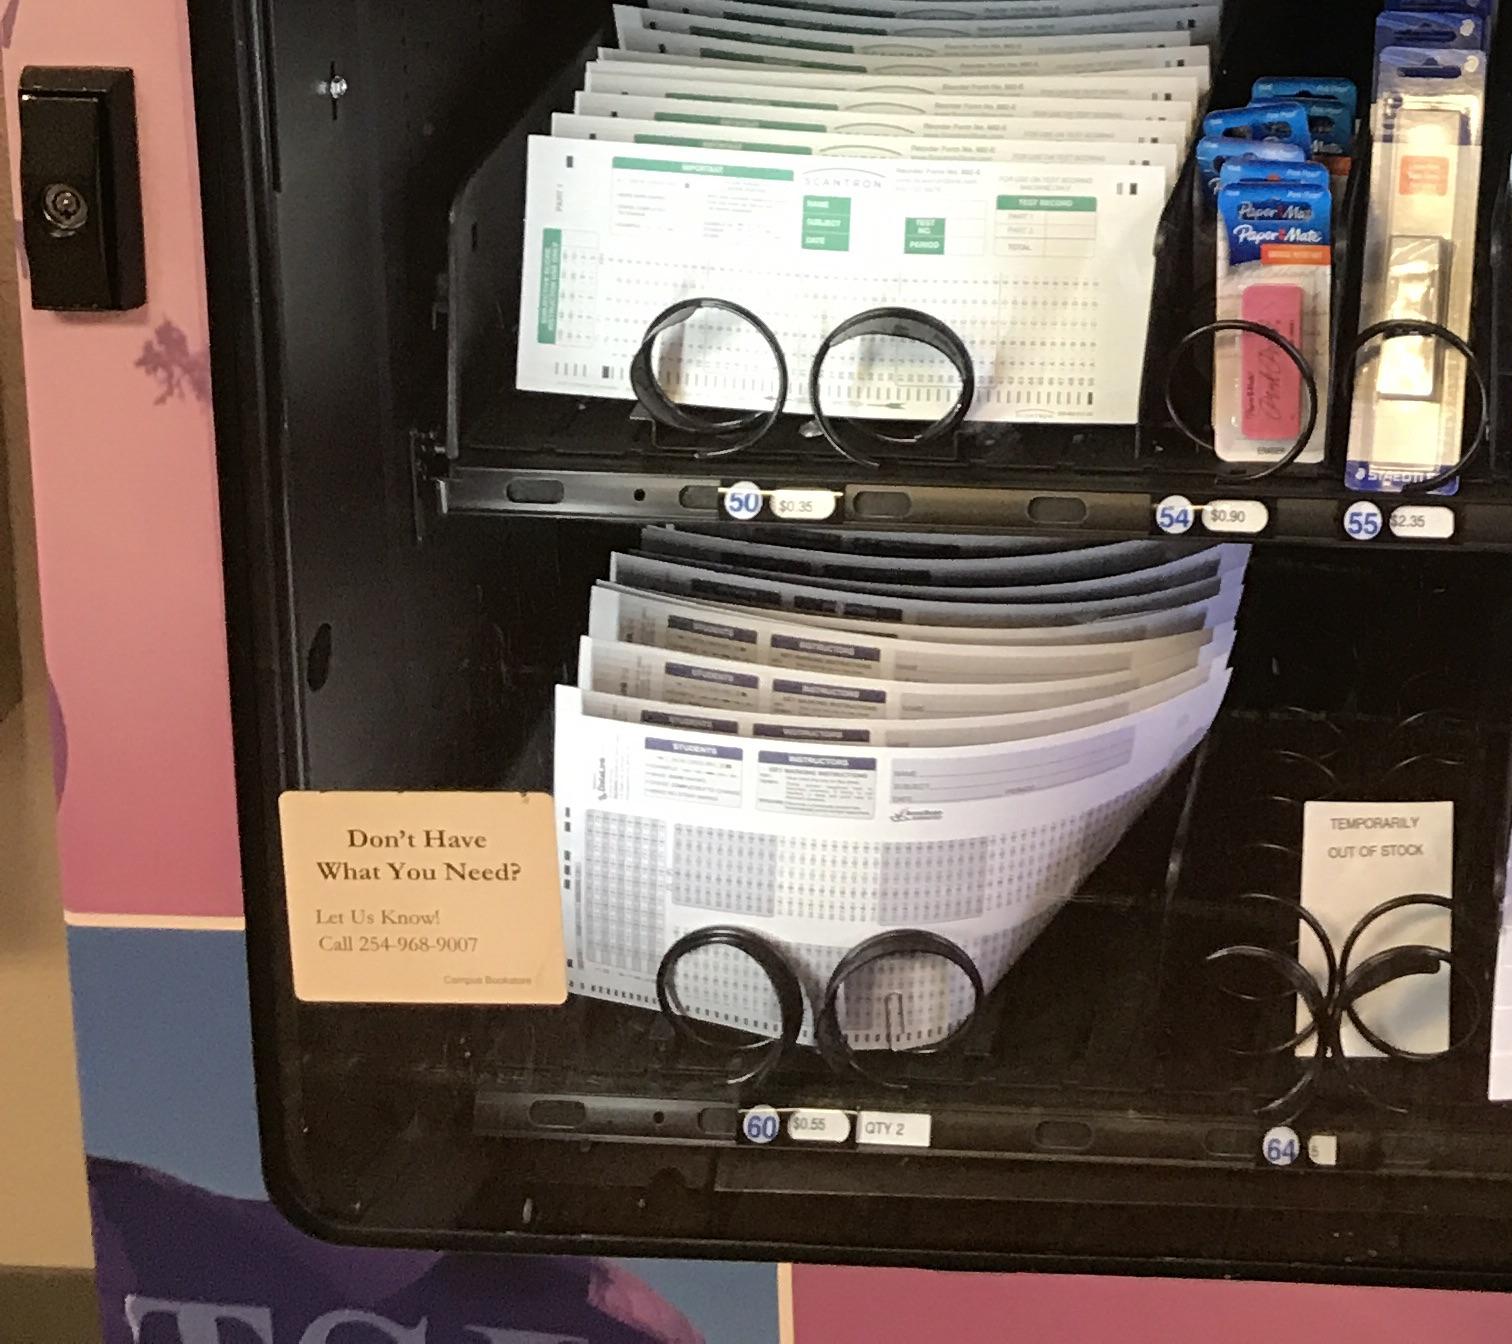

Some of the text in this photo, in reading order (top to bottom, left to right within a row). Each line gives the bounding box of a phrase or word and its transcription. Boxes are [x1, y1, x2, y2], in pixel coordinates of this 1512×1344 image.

[1159, 507, 1246, 528] 54 $0.90
[1349, 512, 1425, 533] 55 $2.35
[1331, 817, 1420, 830] TEMPORARILY
[347, 828, 488, 849] Don't Have
[1328, 844, 1424, 858] OUT OF STOCK
[317, 861, 522, 881] What You Need?
[315, 909, 441, 925] Let Us Know!
[318, 936, 478, 953] Call 254-968-9007
[747, 1114, 891, 1139] 60 QTY
